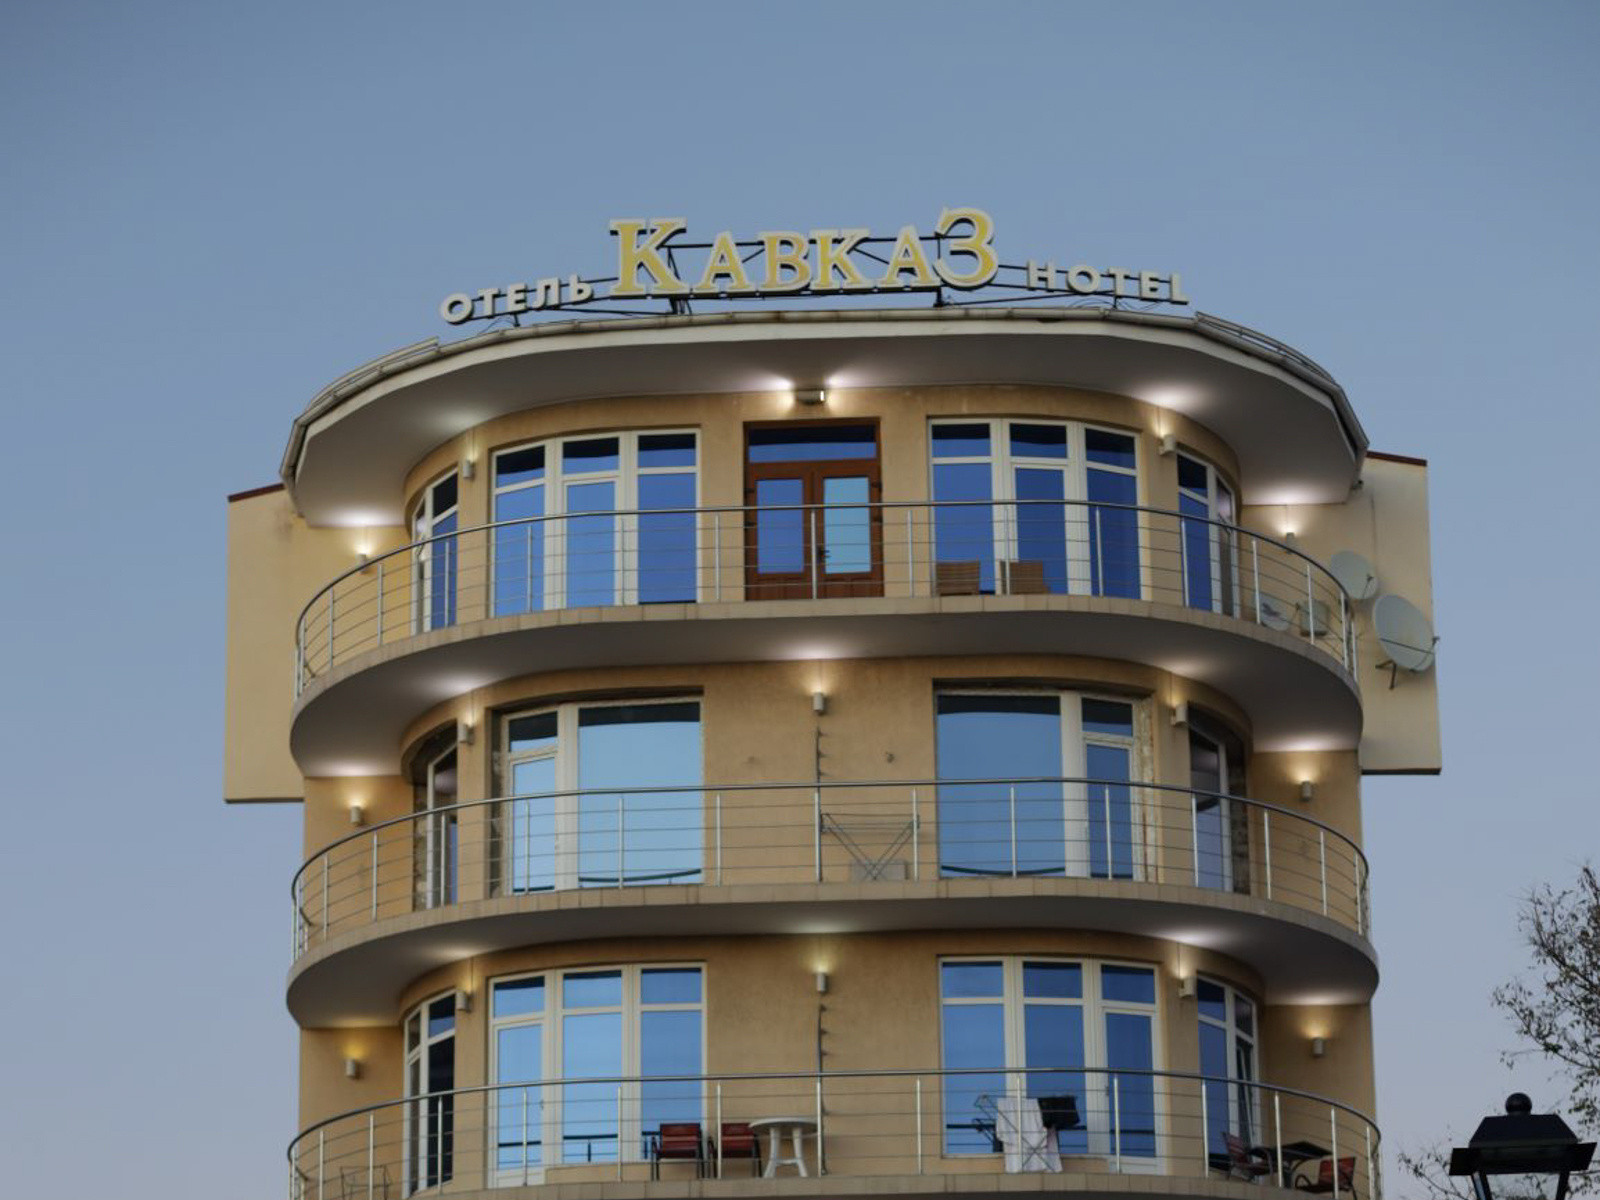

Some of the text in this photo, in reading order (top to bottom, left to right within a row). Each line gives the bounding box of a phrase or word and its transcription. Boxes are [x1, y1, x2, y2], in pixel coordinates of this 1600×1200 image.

[440, 207, 999, 325] ОТЕЛЬ КАВКАЗ
[1025, 259, 1188, 305] HOTEL
